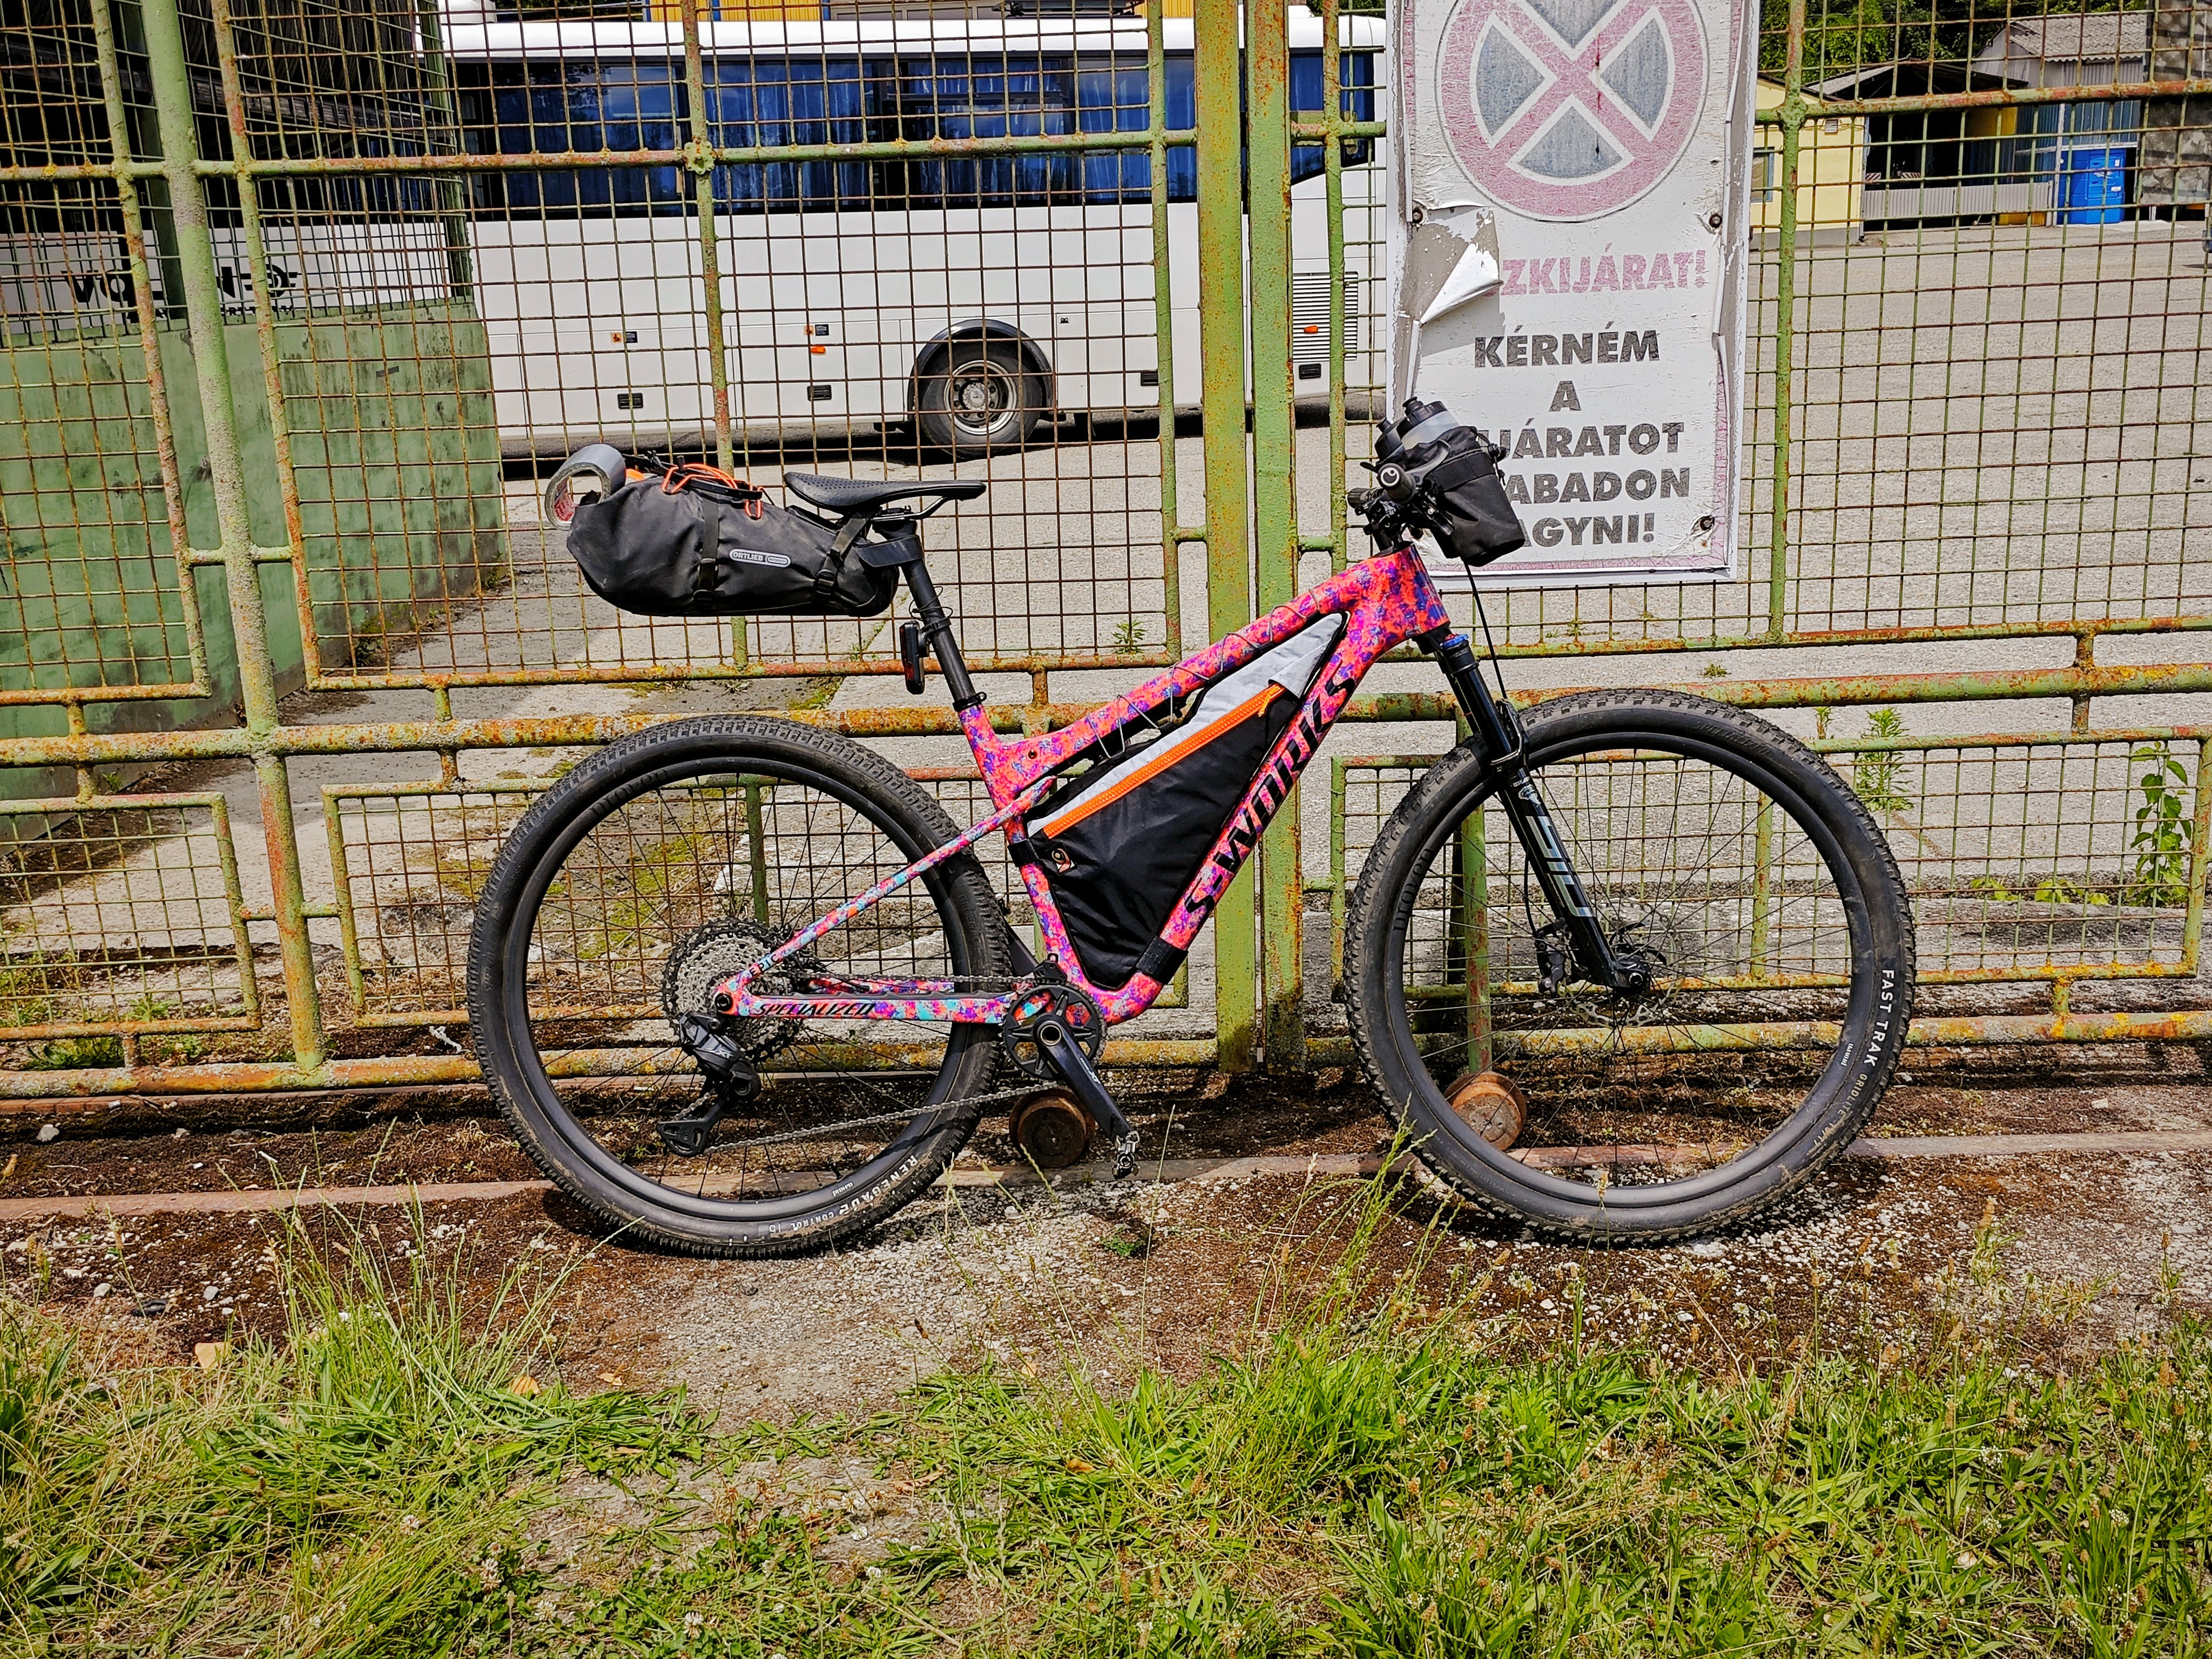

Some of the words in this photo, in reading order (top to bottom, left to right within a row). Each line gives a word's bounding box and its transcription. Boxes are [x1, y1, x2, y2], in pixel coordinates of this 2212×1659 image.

[1499, 242, 1707, 296] ZKIJÁRAT!
[1474, 321, 1660, 368] KÉRNÉM
[1548, 380, 1582, 413] A
[1478, 417, 1684, 459] JÁRATOT
[1504, 467, 1690, 505] ABADON
[732, 551, 764, 562] ORTLIEB
[1183, 658, 1356, 914] S-WORKS
[749, 954, 780, 977] EPIC
[758, 1003, 877, 1016] SPECIALIZED
[1879, 969, 1894, 1014] FAST
[1863, 1020, 1889, 1067] TRAK
[1837, 1073, 1868, 1117] GRIDLITE
[838, 1154, 919, 1216] RENEGADE
[790, 1211, 835, 1231] CONTROL
